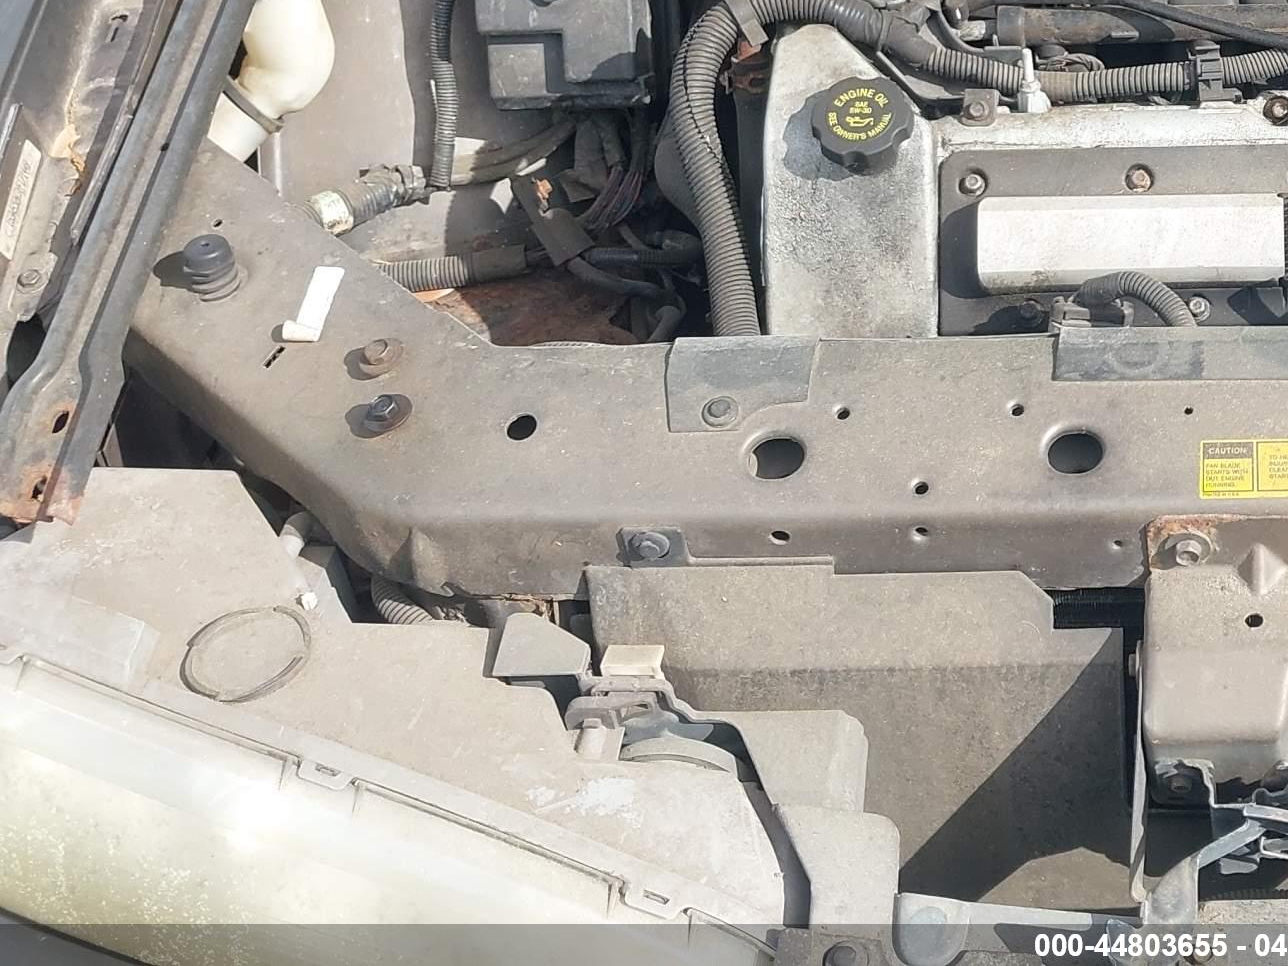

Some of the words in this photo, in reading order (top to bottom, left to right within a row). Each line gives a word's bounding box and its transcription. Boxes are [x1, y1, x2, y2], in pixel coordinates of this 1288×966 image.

[834, 88, 875, 107] ENGINE
[875, 93, 889, 108] OIL
[828, 112, 838, 126] SEE
[833, 125, 867, 140] OWNER'S
[867, 112, 892, 138] MANUAL
[1208, 447, 1248, 455] CAUTION
